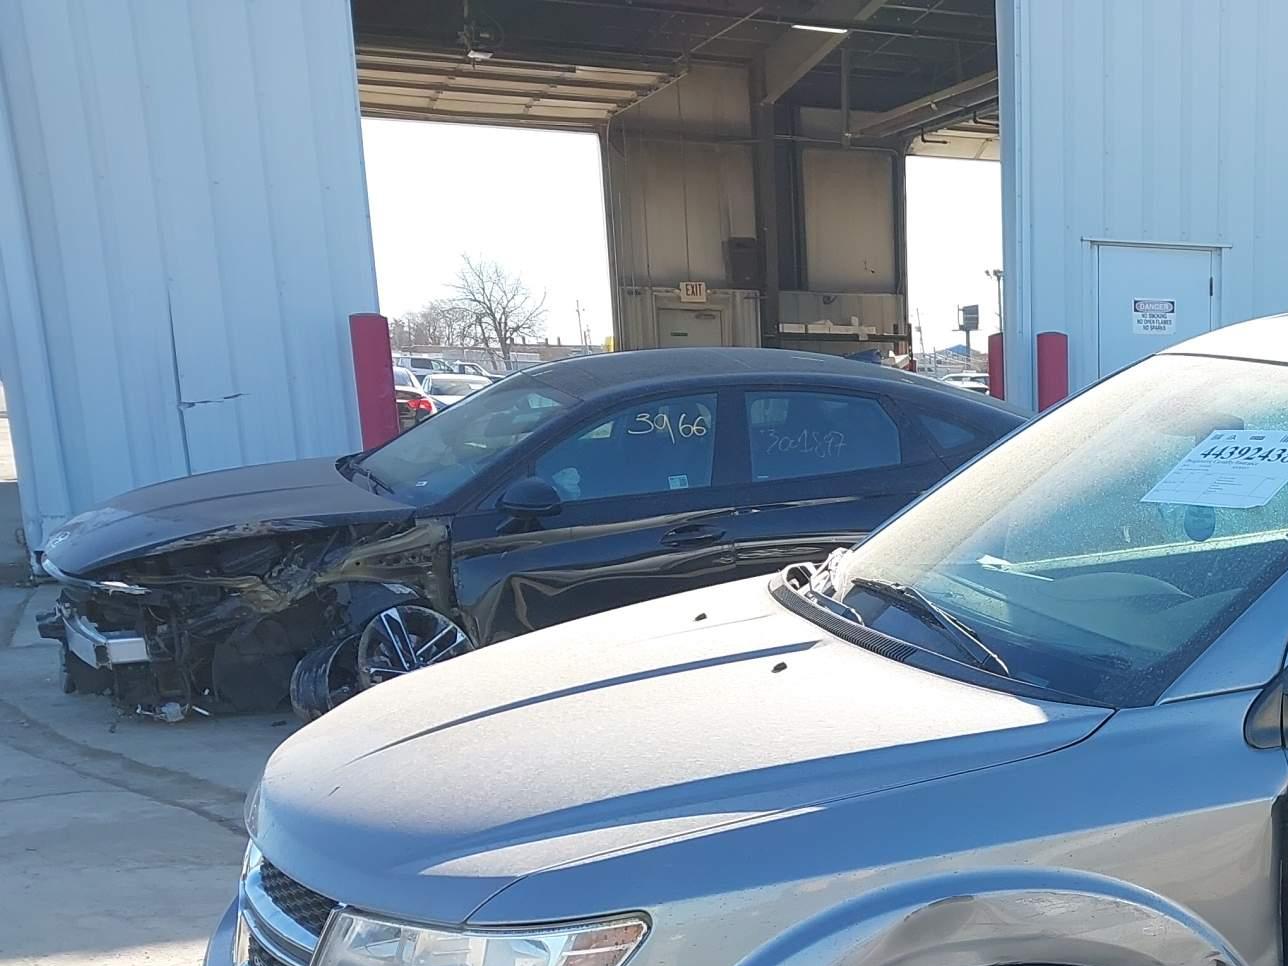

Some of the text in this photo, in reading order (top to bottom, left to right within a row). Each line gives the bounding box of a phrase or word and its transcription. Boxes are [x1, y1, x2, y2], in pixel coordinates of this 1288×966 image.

[685, 283, 702, 297] EXIT
[1139, 303, 1170, 311] DANGER
[627, 413, 707, 444] 3966
